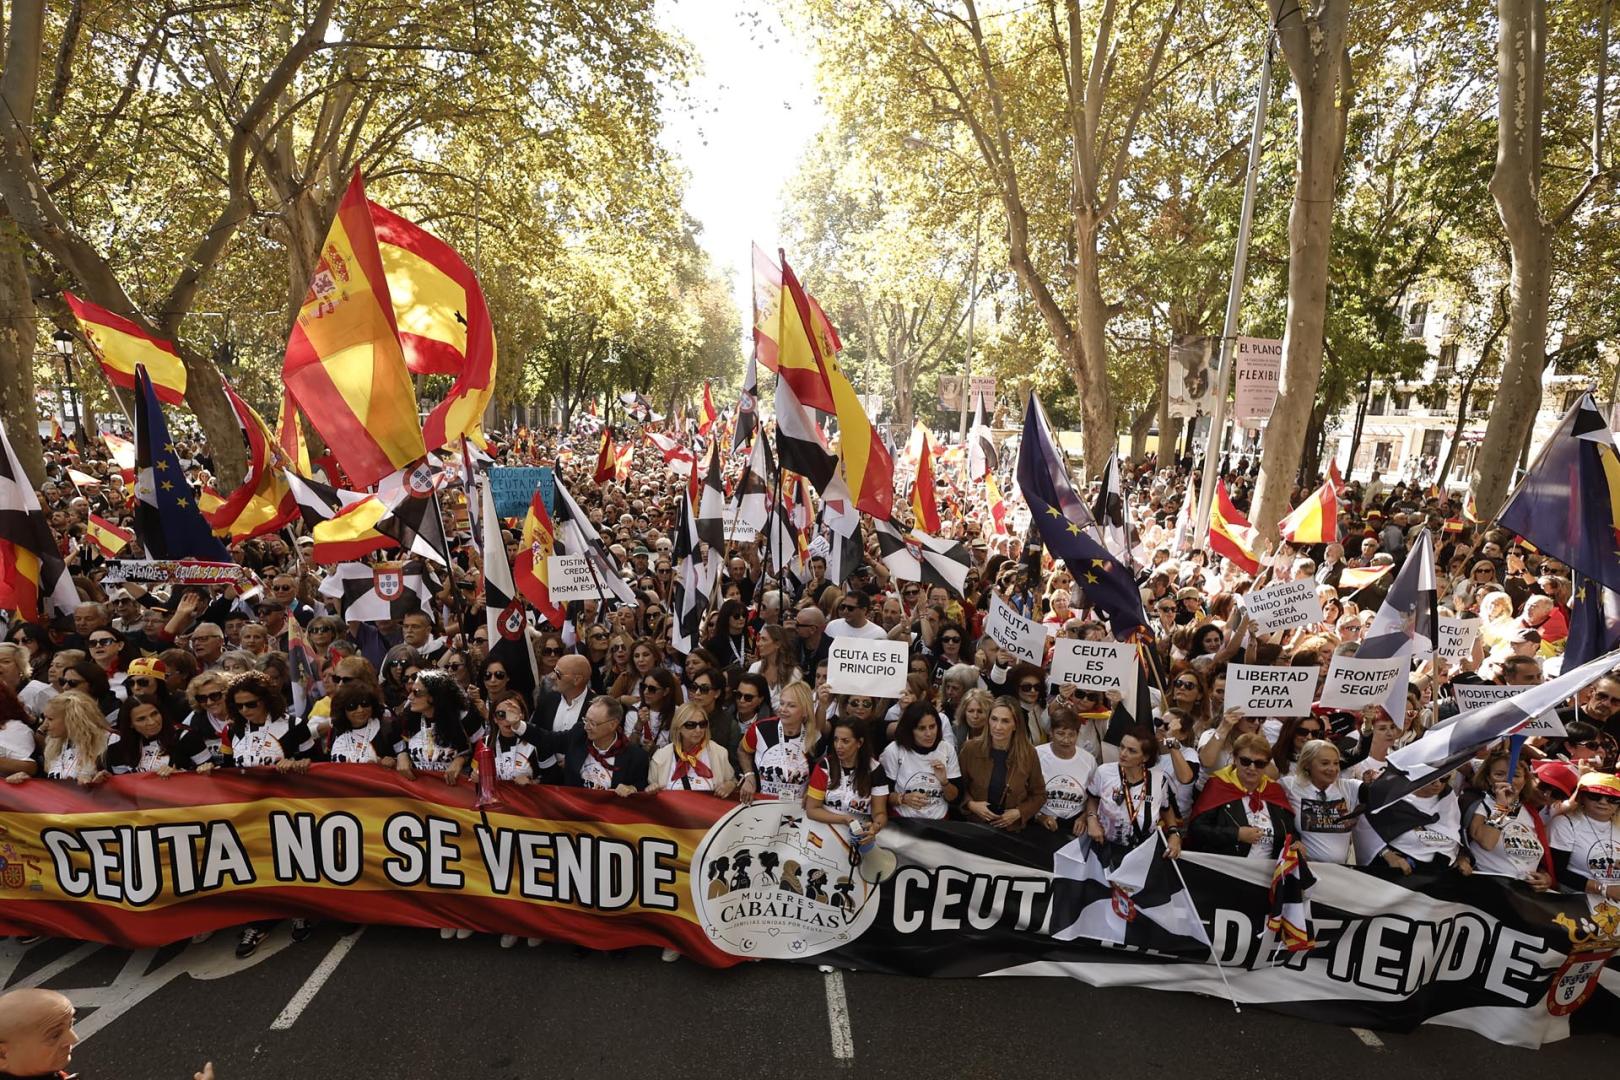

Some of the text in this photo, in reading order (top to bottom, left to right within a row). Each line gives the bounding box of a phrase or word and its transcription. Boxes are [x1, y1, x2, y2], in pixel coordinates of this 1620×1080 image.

[1240, 344, 1282, 355] EL PLANO
[1239, 370, 1280, 381] FLEXIBL
[573, 576, 590, 584] UNA
[1252, 583, 1305, 603] EL PUEBLO
[1250, 600, 1281, 614] UNIDO
[998, 605, 1030, 634] CEUTA
[1265, 612, 1308, 628] VENCIDO
[1004, 626, 1018, 641] ES
[1439, 624, 1470, 635] CEUTA
[993, 627, 1034, 659] EUROPA
[1447, 637, 1463, 646] NO
[833, 649, 904, 664] CEUTA ES EL
[1072, 645, 1118, 659] CEUTA
[1438, 648, 1455, 656] UN
[840, 662, 896, 676] PRINCIPIO
[1086, 660, 1104, 671] ES
[1064, 672, 1121, 687] EUROPA
[1236, 669, 1309, 682] LIBERTAD
[1334, 668, 1400, 681] FRONTERA
[1251, 685, 1290, 696] PARA
[1340, 683, 1389, 696] SEGURA
[1248, 698, 1293, 709] CEUTA
[42, 811, 678, 910] CEUTA NO SE VENDE
[741, 892, 815, 909] MUJERES
[892, 866, 1054, 935] CEUT
[721, 901, 840, 929] CABALLAS
